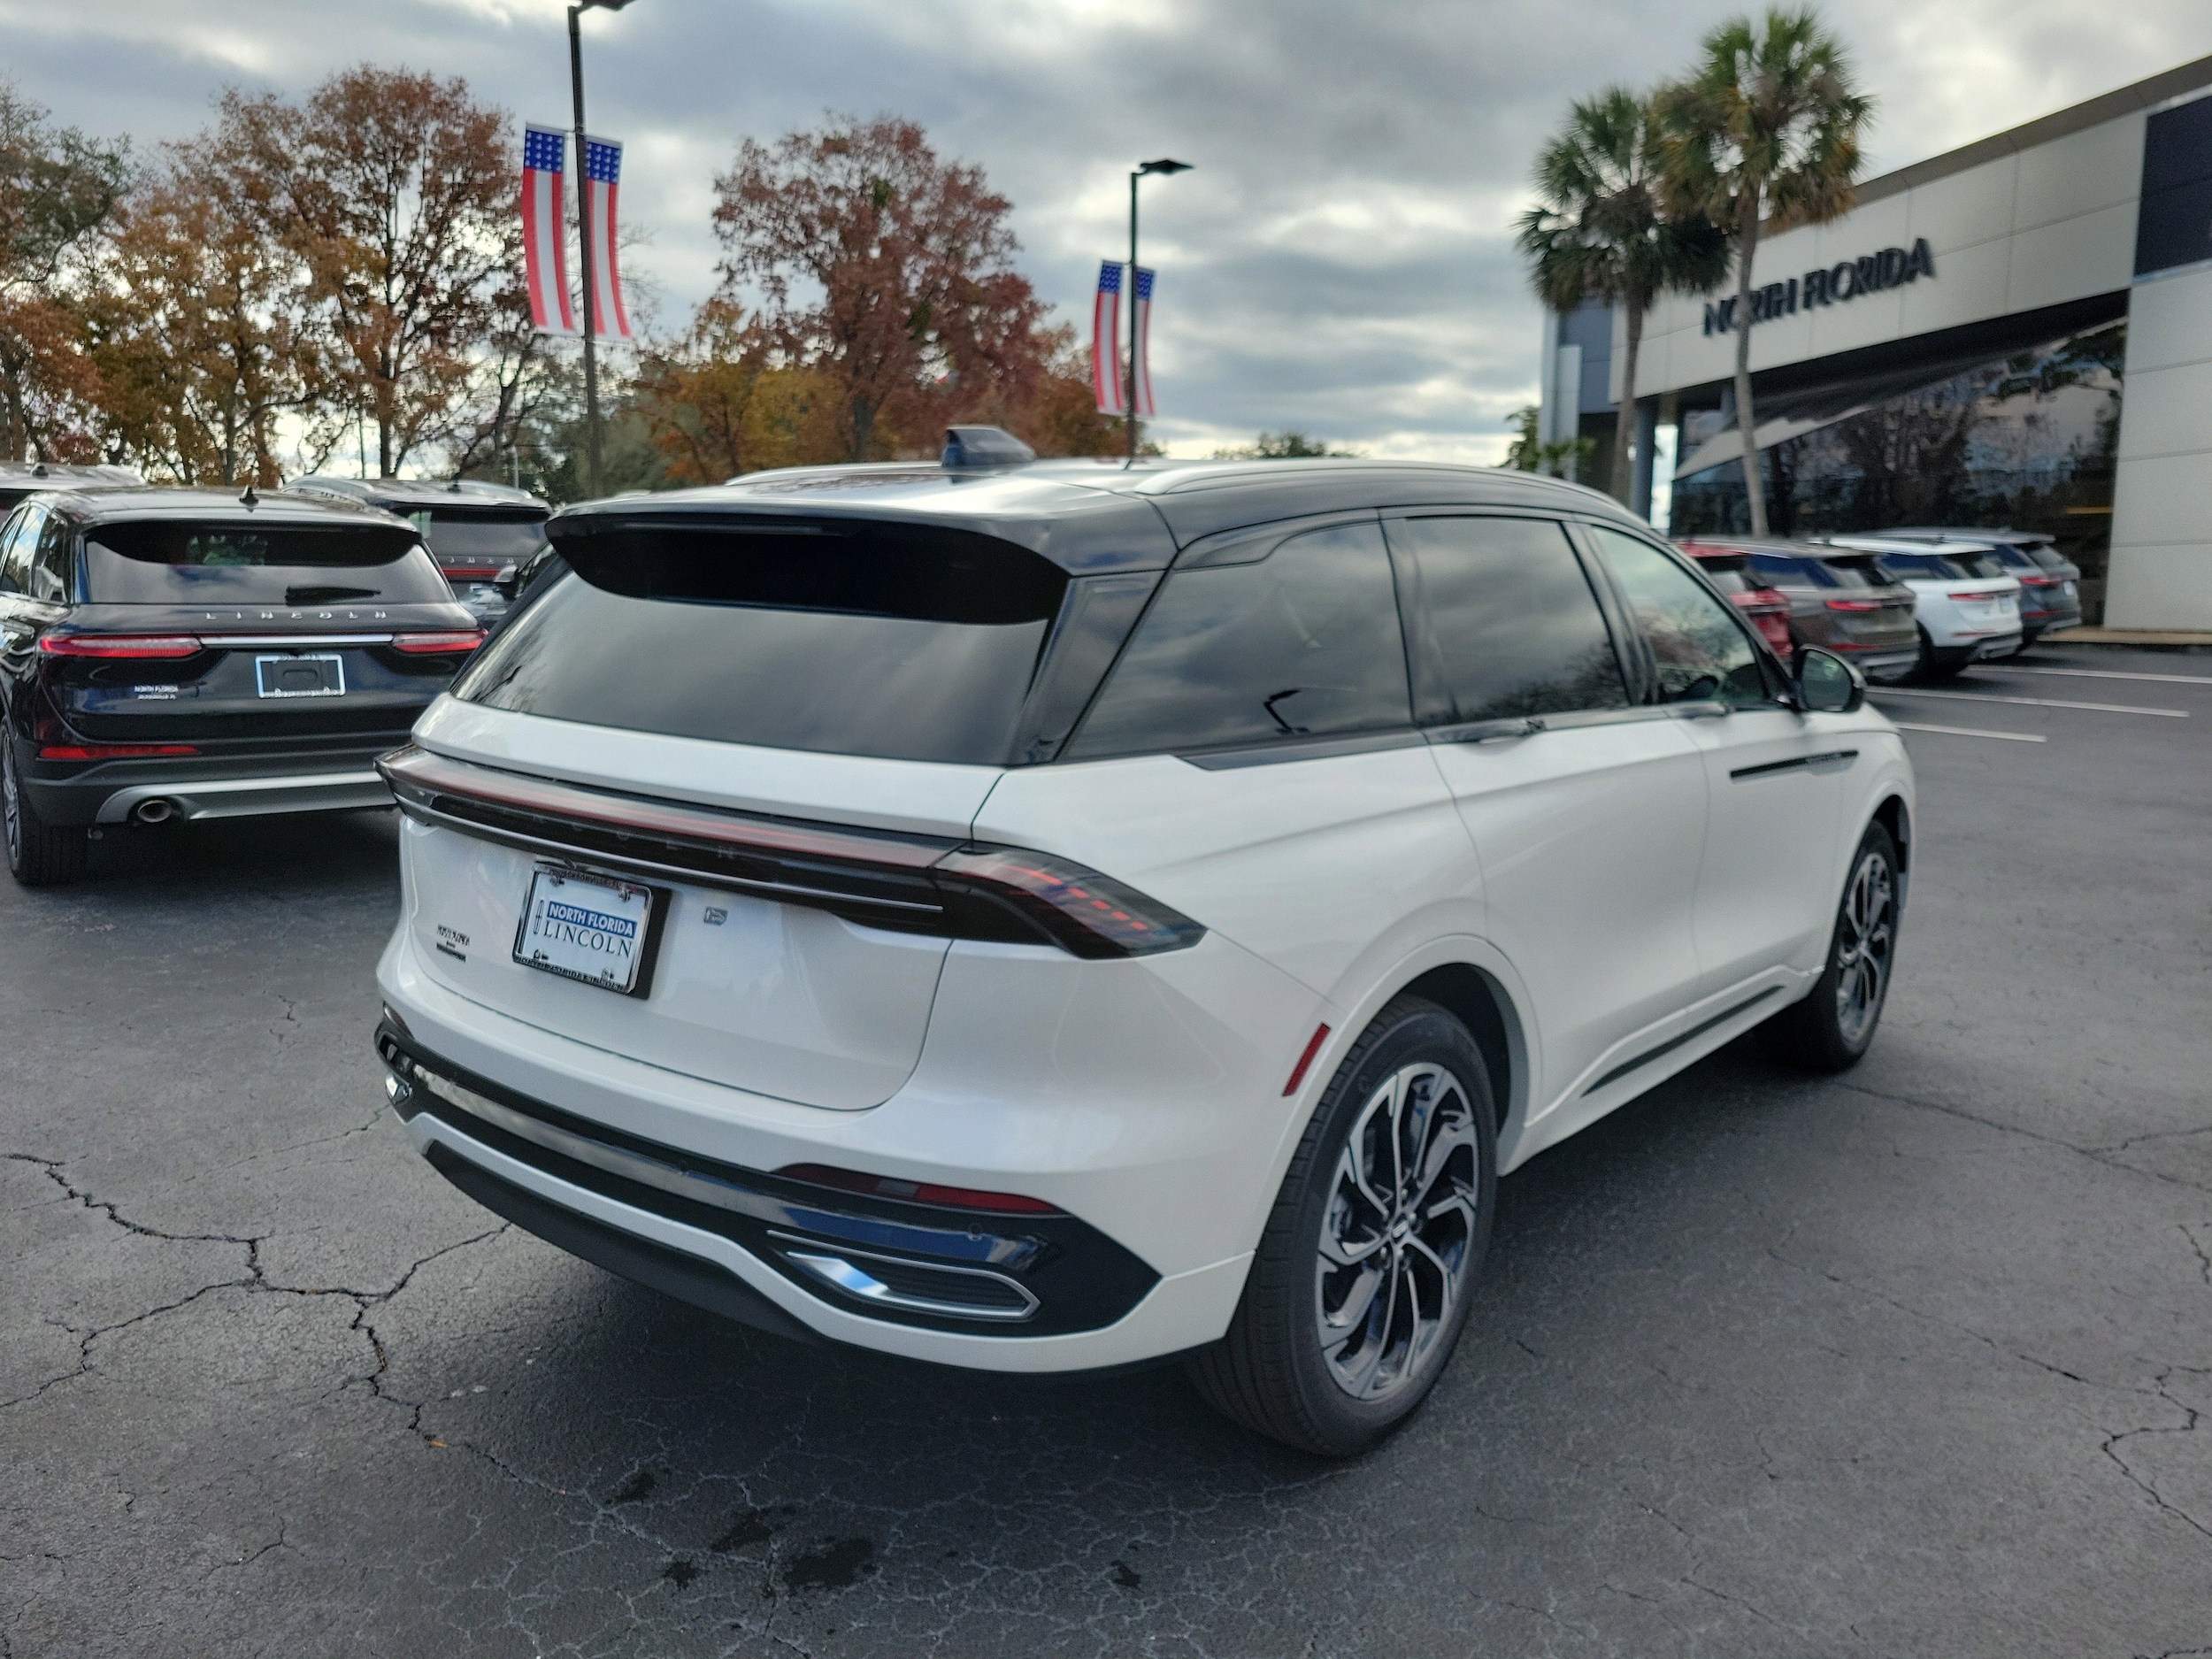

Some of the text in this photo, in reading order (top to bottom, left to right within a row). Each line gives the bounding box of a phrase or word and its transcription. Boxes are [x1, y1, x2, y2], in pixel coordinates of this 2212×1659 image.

[1803, 237, 1935, 310] FLORIDA
[543, 920, 634, 959] LINCOLN
[549, 903, 634, 938] NORTH FLORIDA
